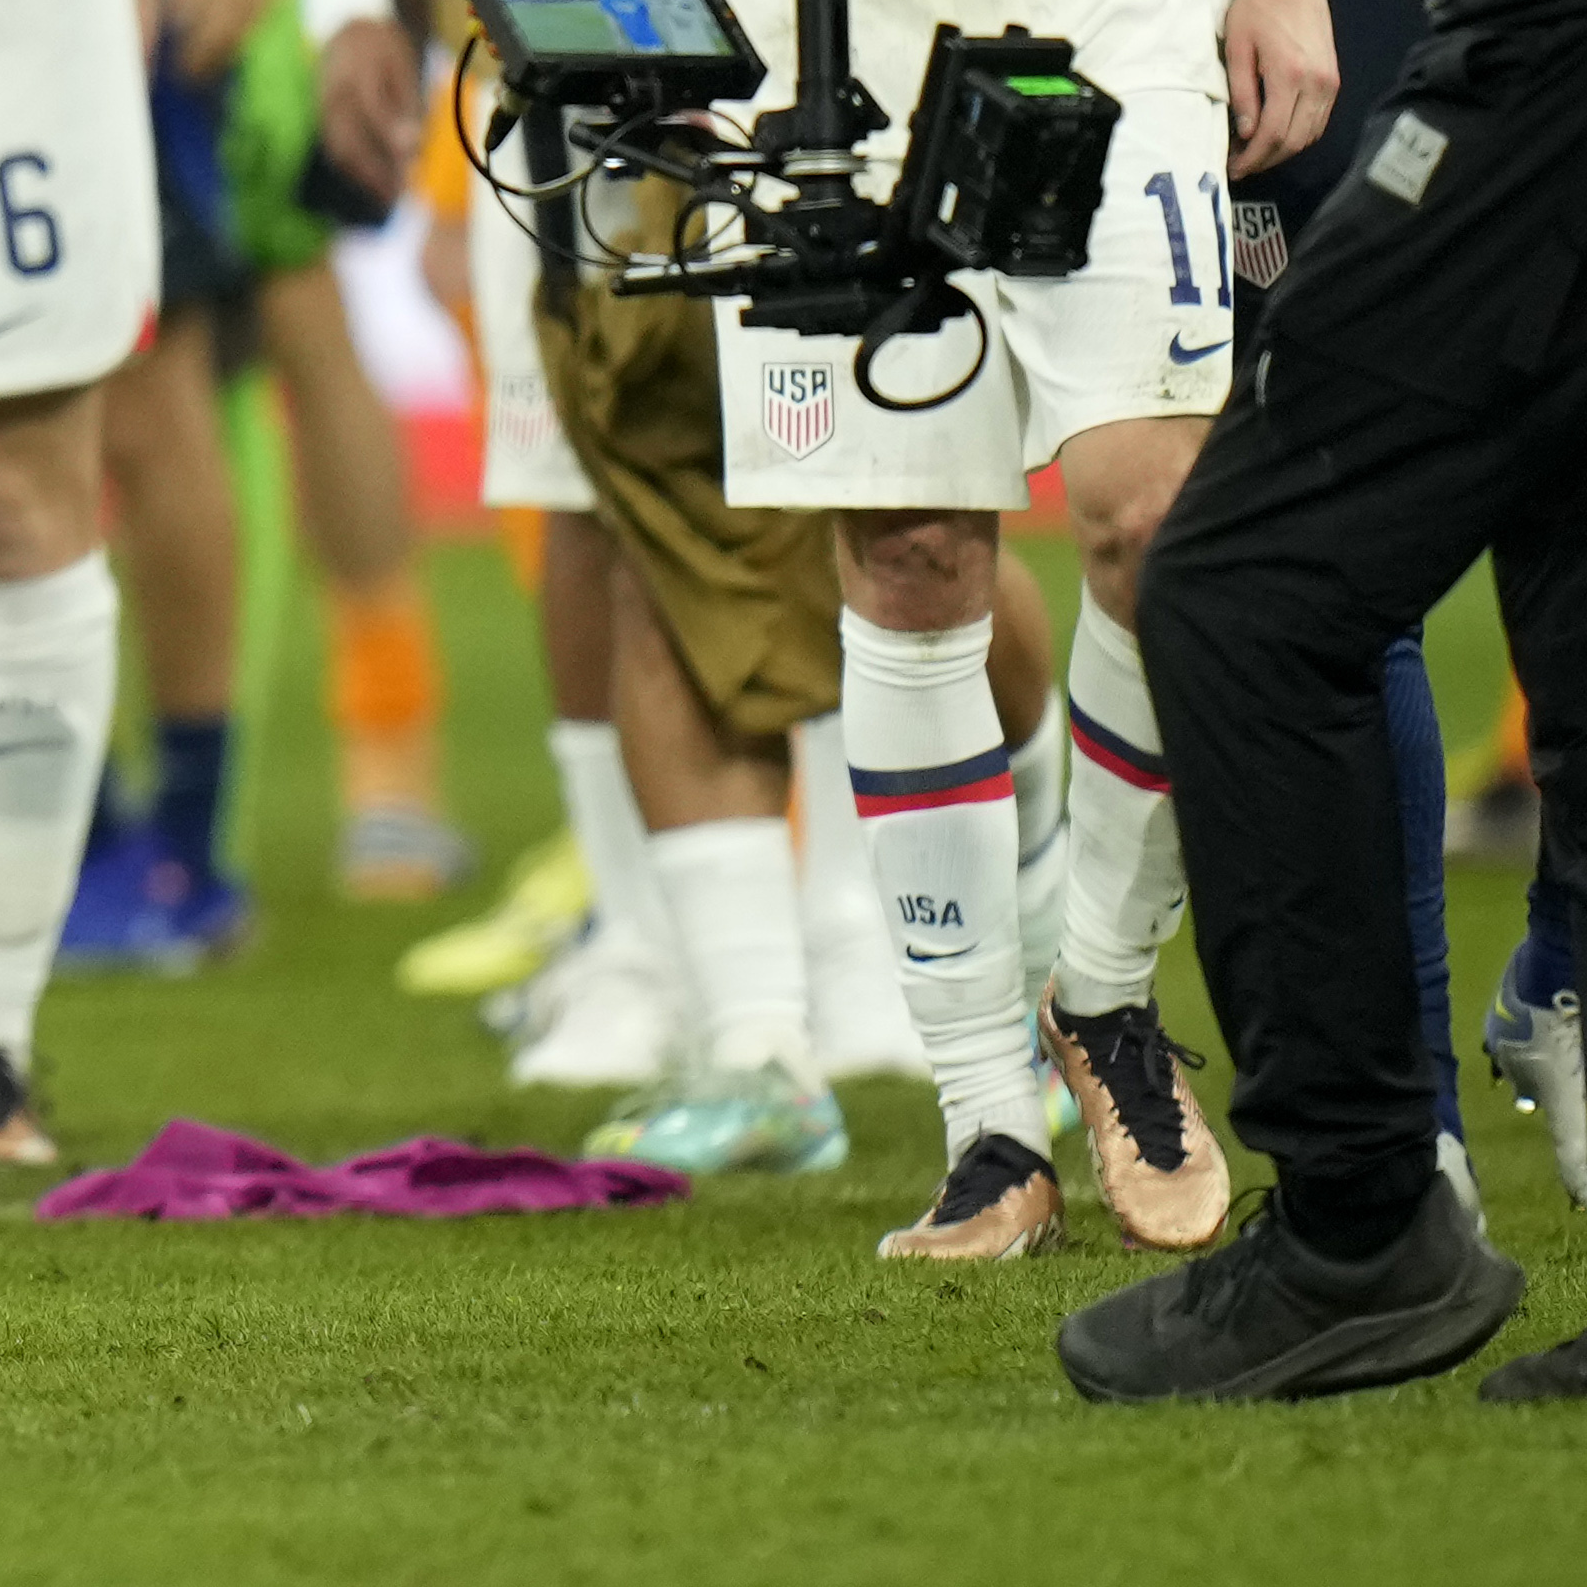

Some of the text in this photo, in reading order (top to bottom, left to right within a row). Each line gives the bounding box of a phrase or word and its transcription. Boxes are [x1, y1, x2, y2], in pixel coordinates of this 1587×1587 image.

[1144, 171, 1231, 310] 11
[769, 369, 827, 404] USA
[897, 894, 964, 928] USA
